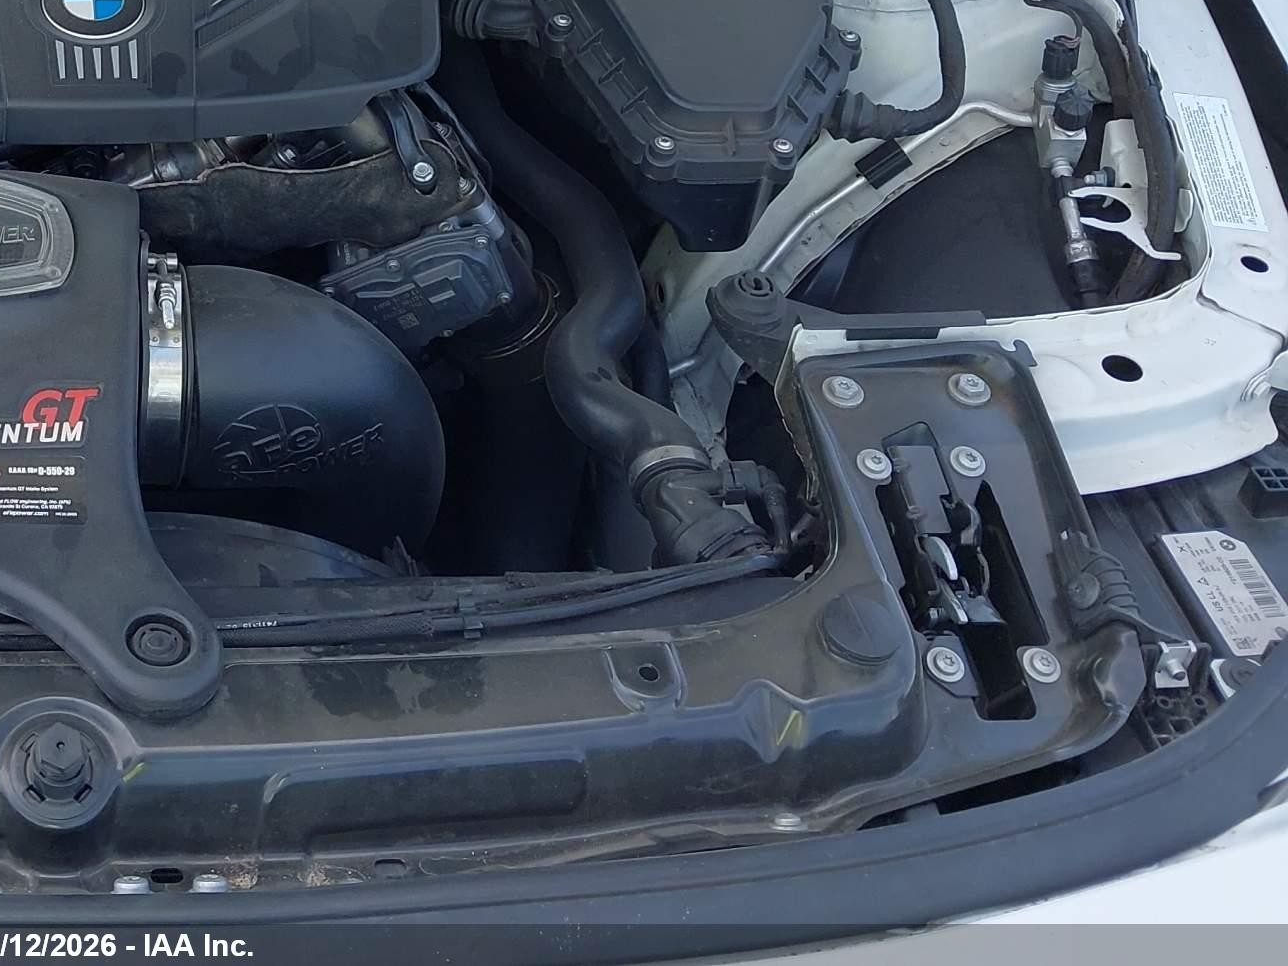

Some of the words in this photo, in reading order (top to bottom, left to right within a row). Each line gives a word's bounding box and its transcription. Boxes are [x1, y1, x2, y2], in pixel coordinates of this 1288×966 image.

[22, 388, 100, 430] GT
[275, 422, 384, 474] POWER
[38, 465, 76, 476] D-550-29
